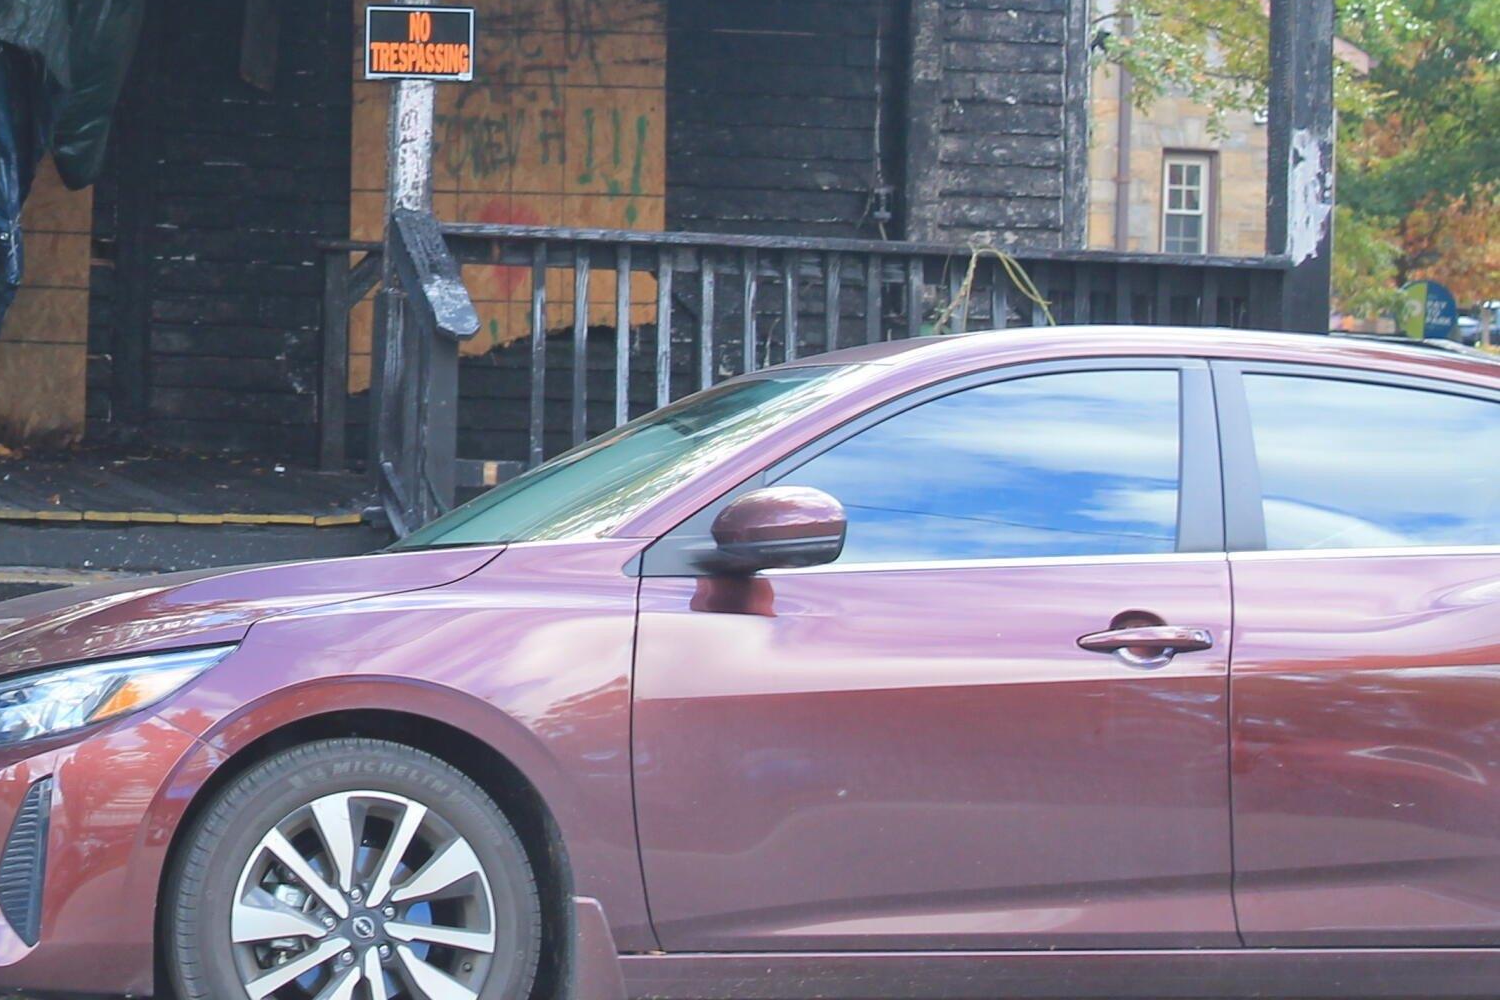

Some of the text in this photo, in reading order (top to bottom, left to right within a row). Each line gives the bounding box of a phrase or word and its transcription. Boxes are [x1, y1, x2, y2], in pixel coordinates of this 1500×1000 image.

[409, 12, 431, 42] NO
[370, 42, 469, 73] TRESPASSING
[333, 760, 447, 793] MICHELIN
